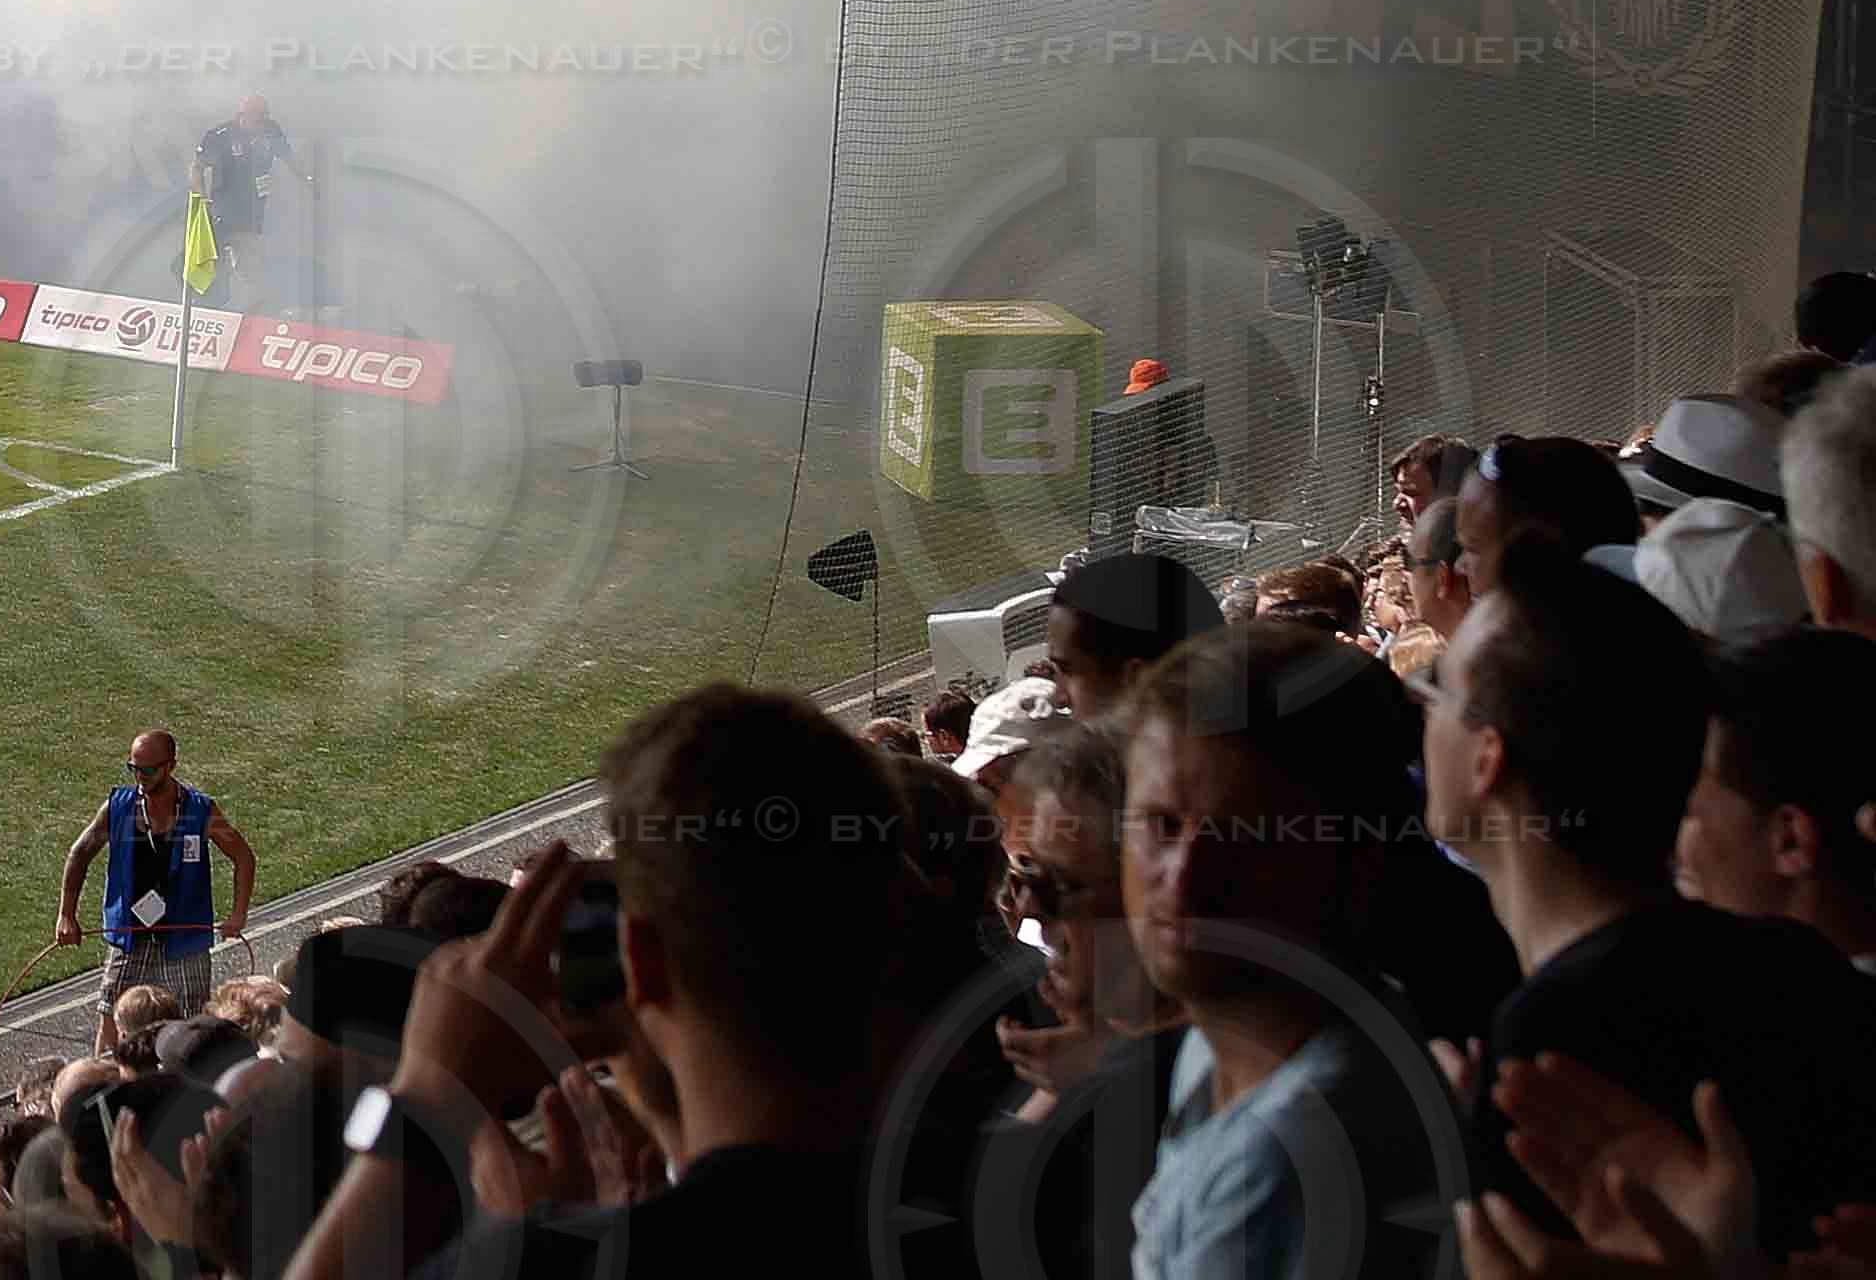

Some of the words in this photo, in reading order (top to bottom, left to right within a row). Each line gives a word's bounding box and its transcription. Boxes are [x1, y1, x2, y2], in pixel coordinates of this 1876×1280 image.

[40, 304, 110, 334] tipico
[156, 328, 219, 358] LIGA
[260, 323, 424, 390] tipico
